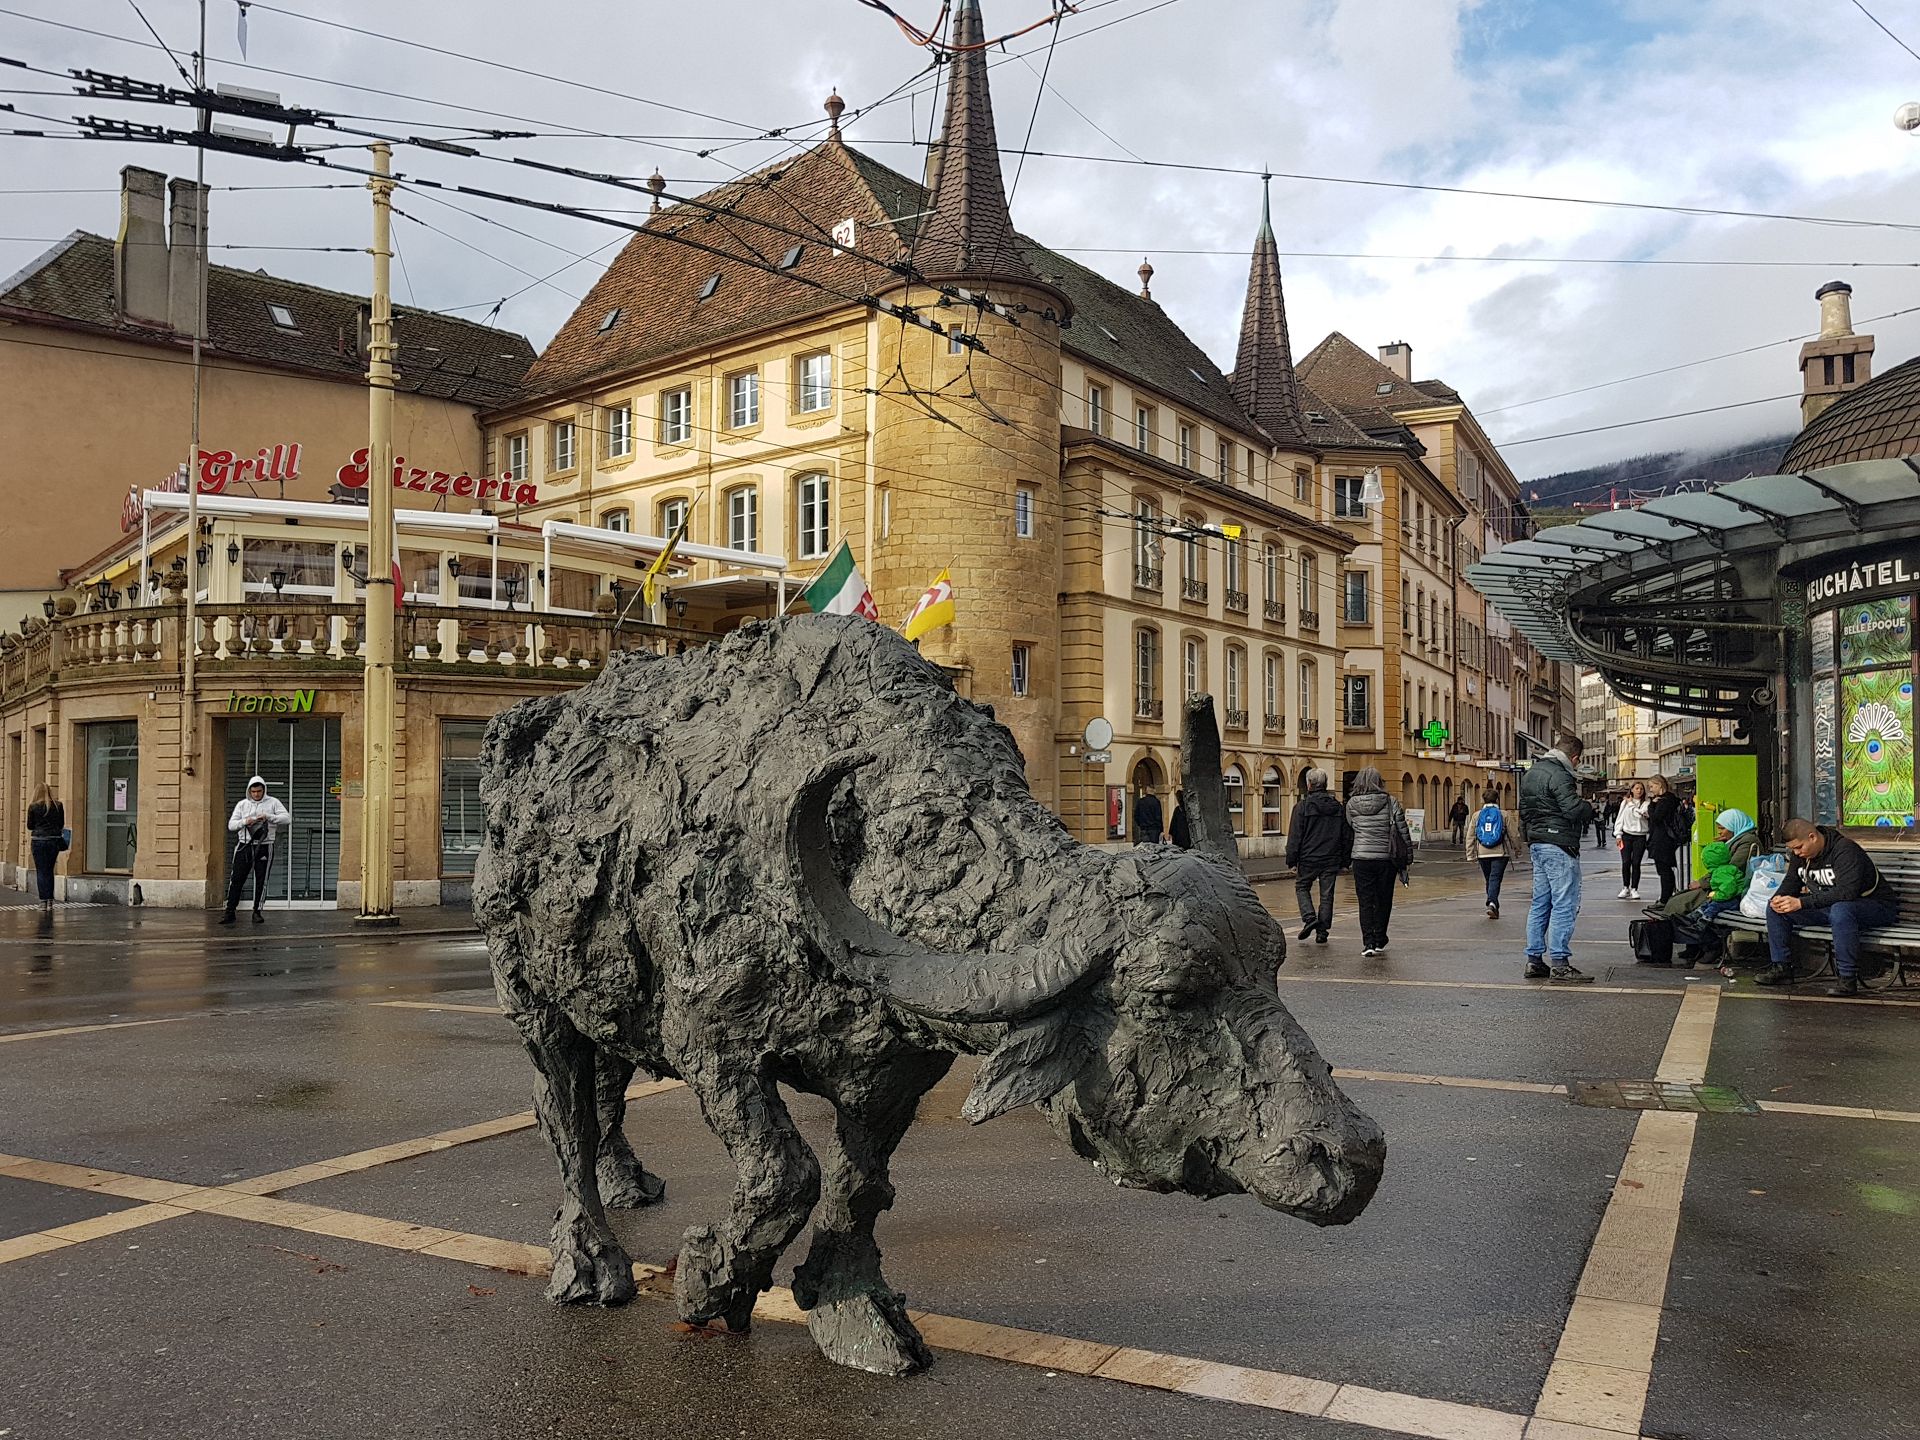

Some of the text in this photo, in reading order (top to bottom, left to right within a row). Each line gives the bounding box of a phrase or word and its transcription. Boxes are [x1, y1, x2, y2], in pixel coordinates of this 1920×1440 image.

[188, 442, 302, 494] Grill
[1843, 616, 1906, 636] BELLE ÉPOQUE
